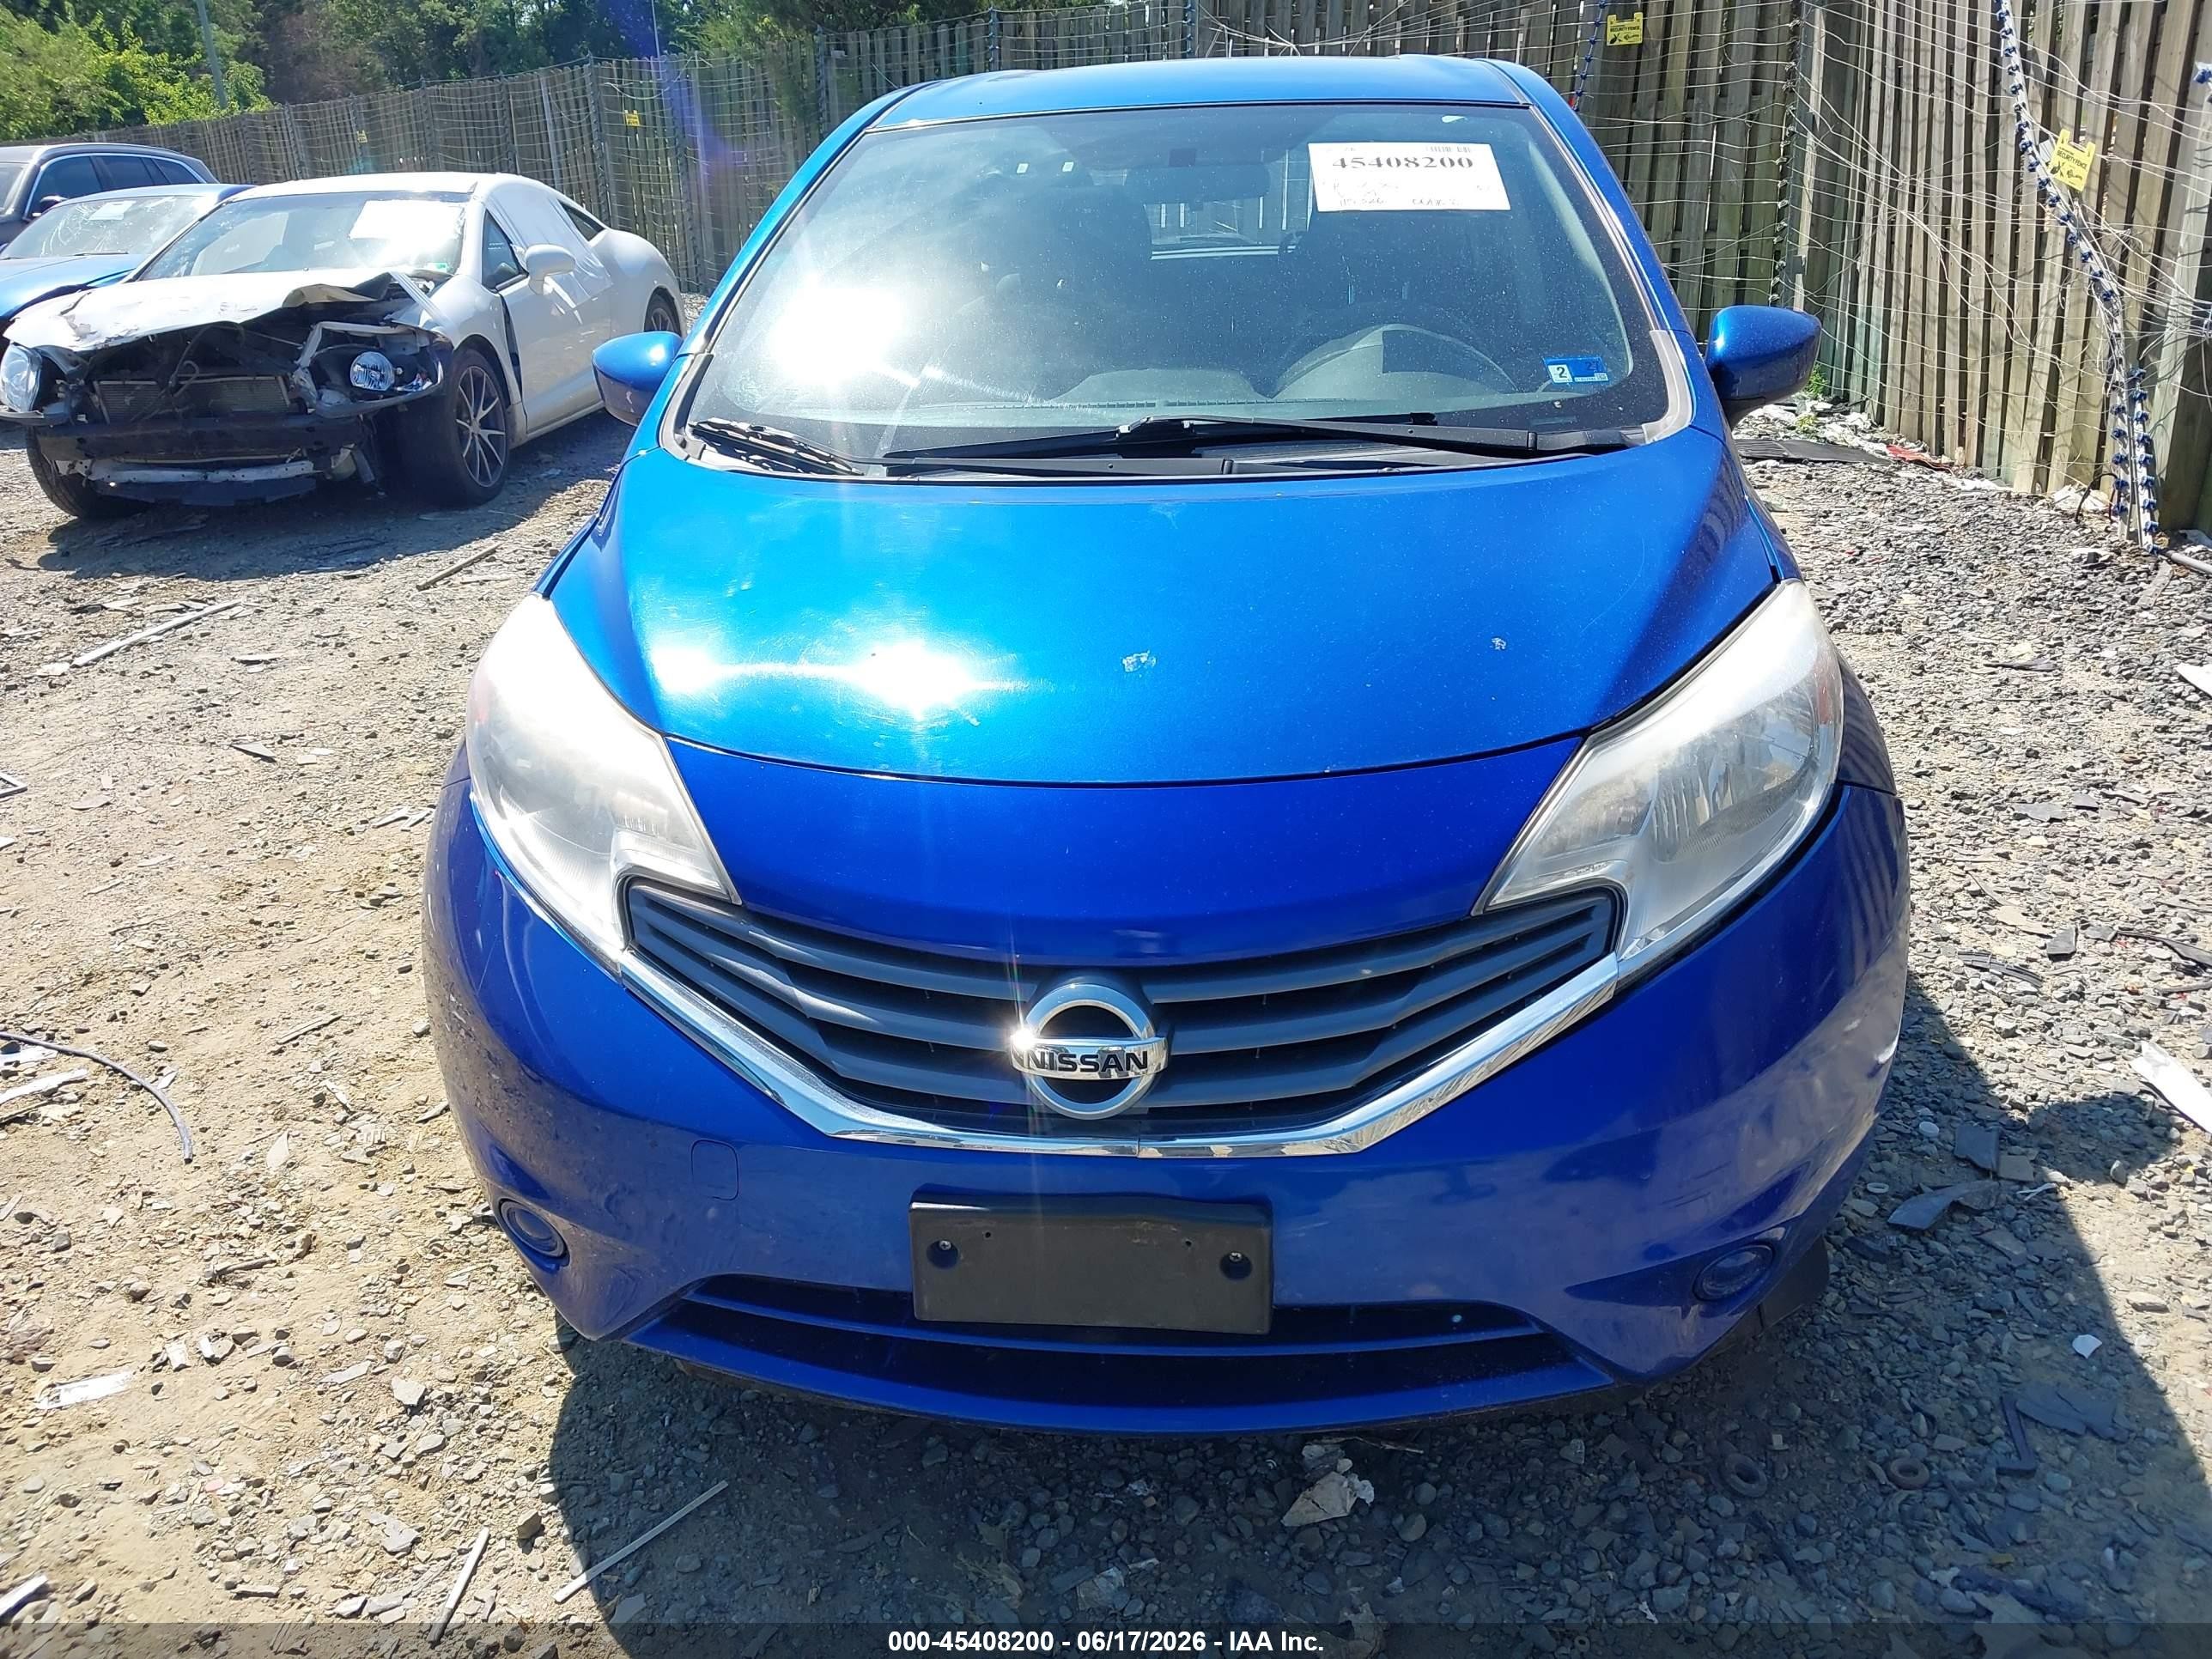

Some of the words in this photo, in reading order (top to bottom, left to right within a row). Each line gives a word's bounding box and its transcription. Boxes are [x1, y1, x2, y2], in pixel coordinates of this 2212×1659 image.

[1332, 156, 1474, 168] 45408200
[2057, 149, 2076, 164] SECURITY
[2075, 159, 2087, 170] FENCE
[1556, 366, 1567, 378] 2
[1025, 1050, 1148, 1073] NISSAN
